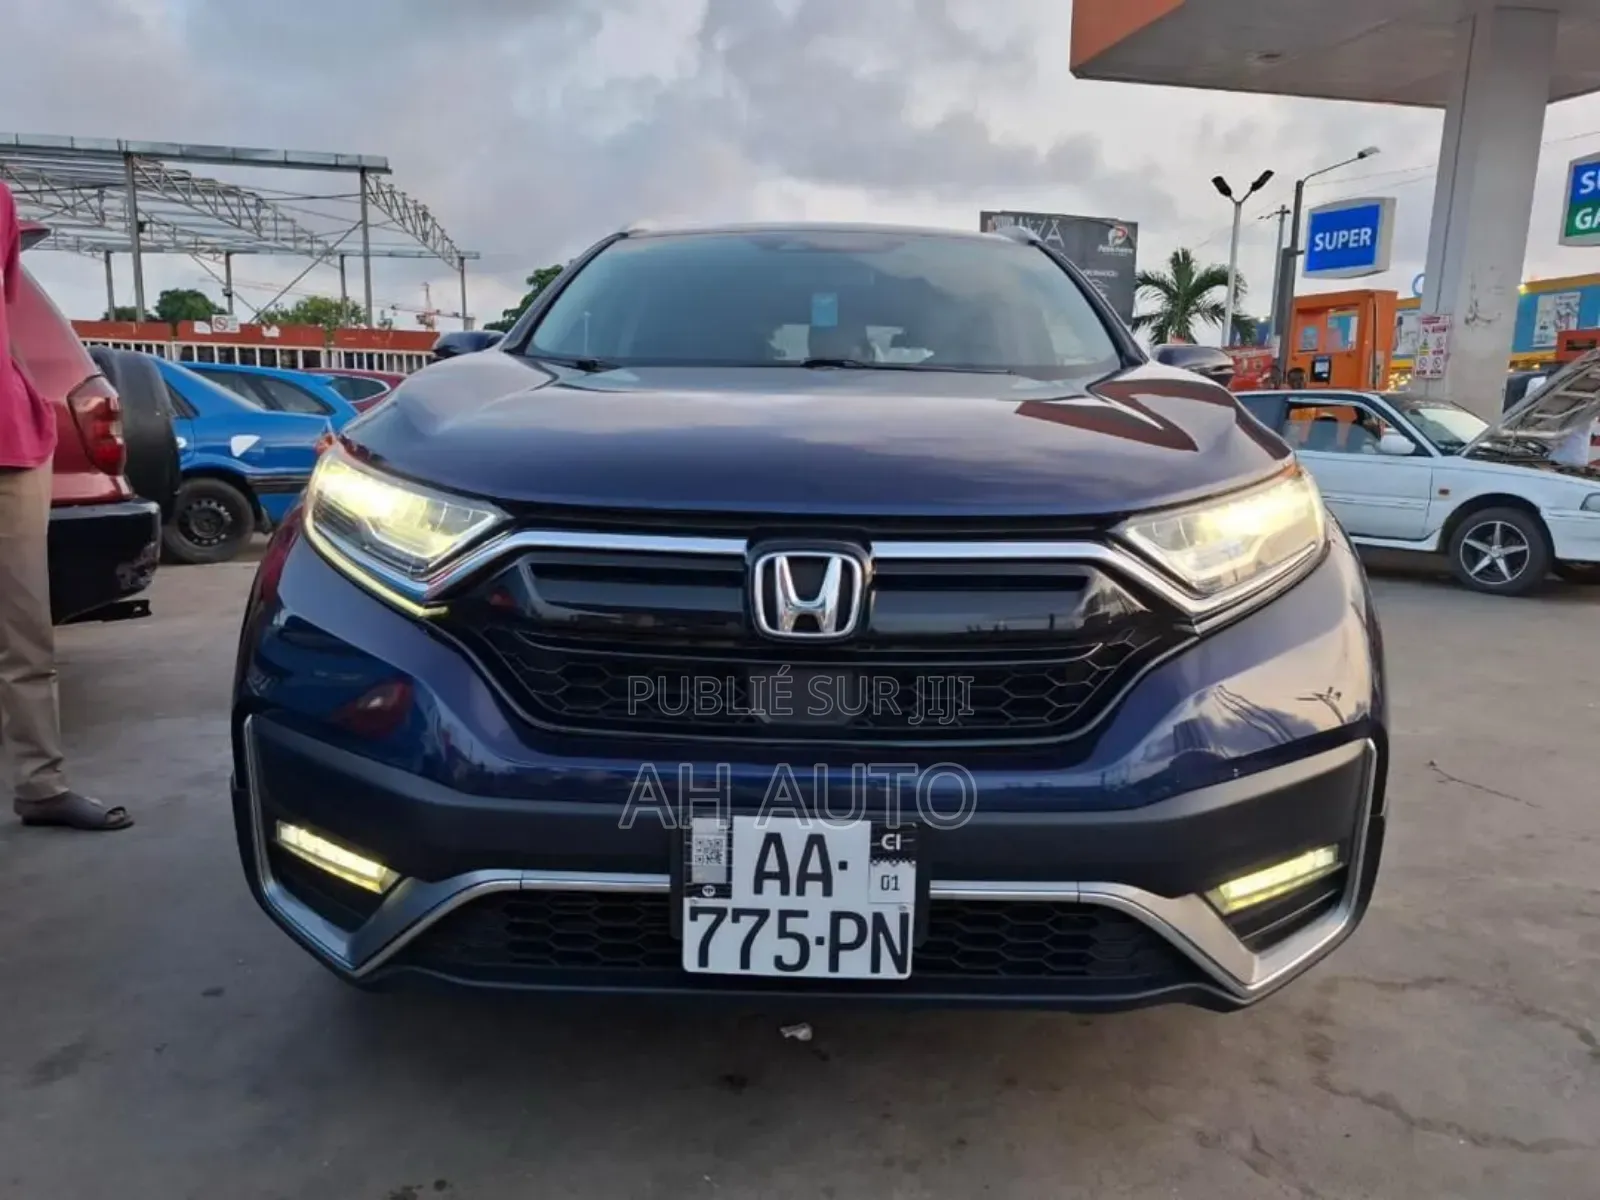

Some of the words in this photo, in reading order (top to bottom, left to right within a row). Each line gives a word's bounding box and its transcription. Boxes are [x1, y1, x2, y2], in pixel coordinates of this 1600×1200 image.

[1579, 169, 1600, 194] S
[1314, 227, 1372, 252] SUPER
[881, 833, 902, 850] CI
[880, 875, 900, 891] 01
